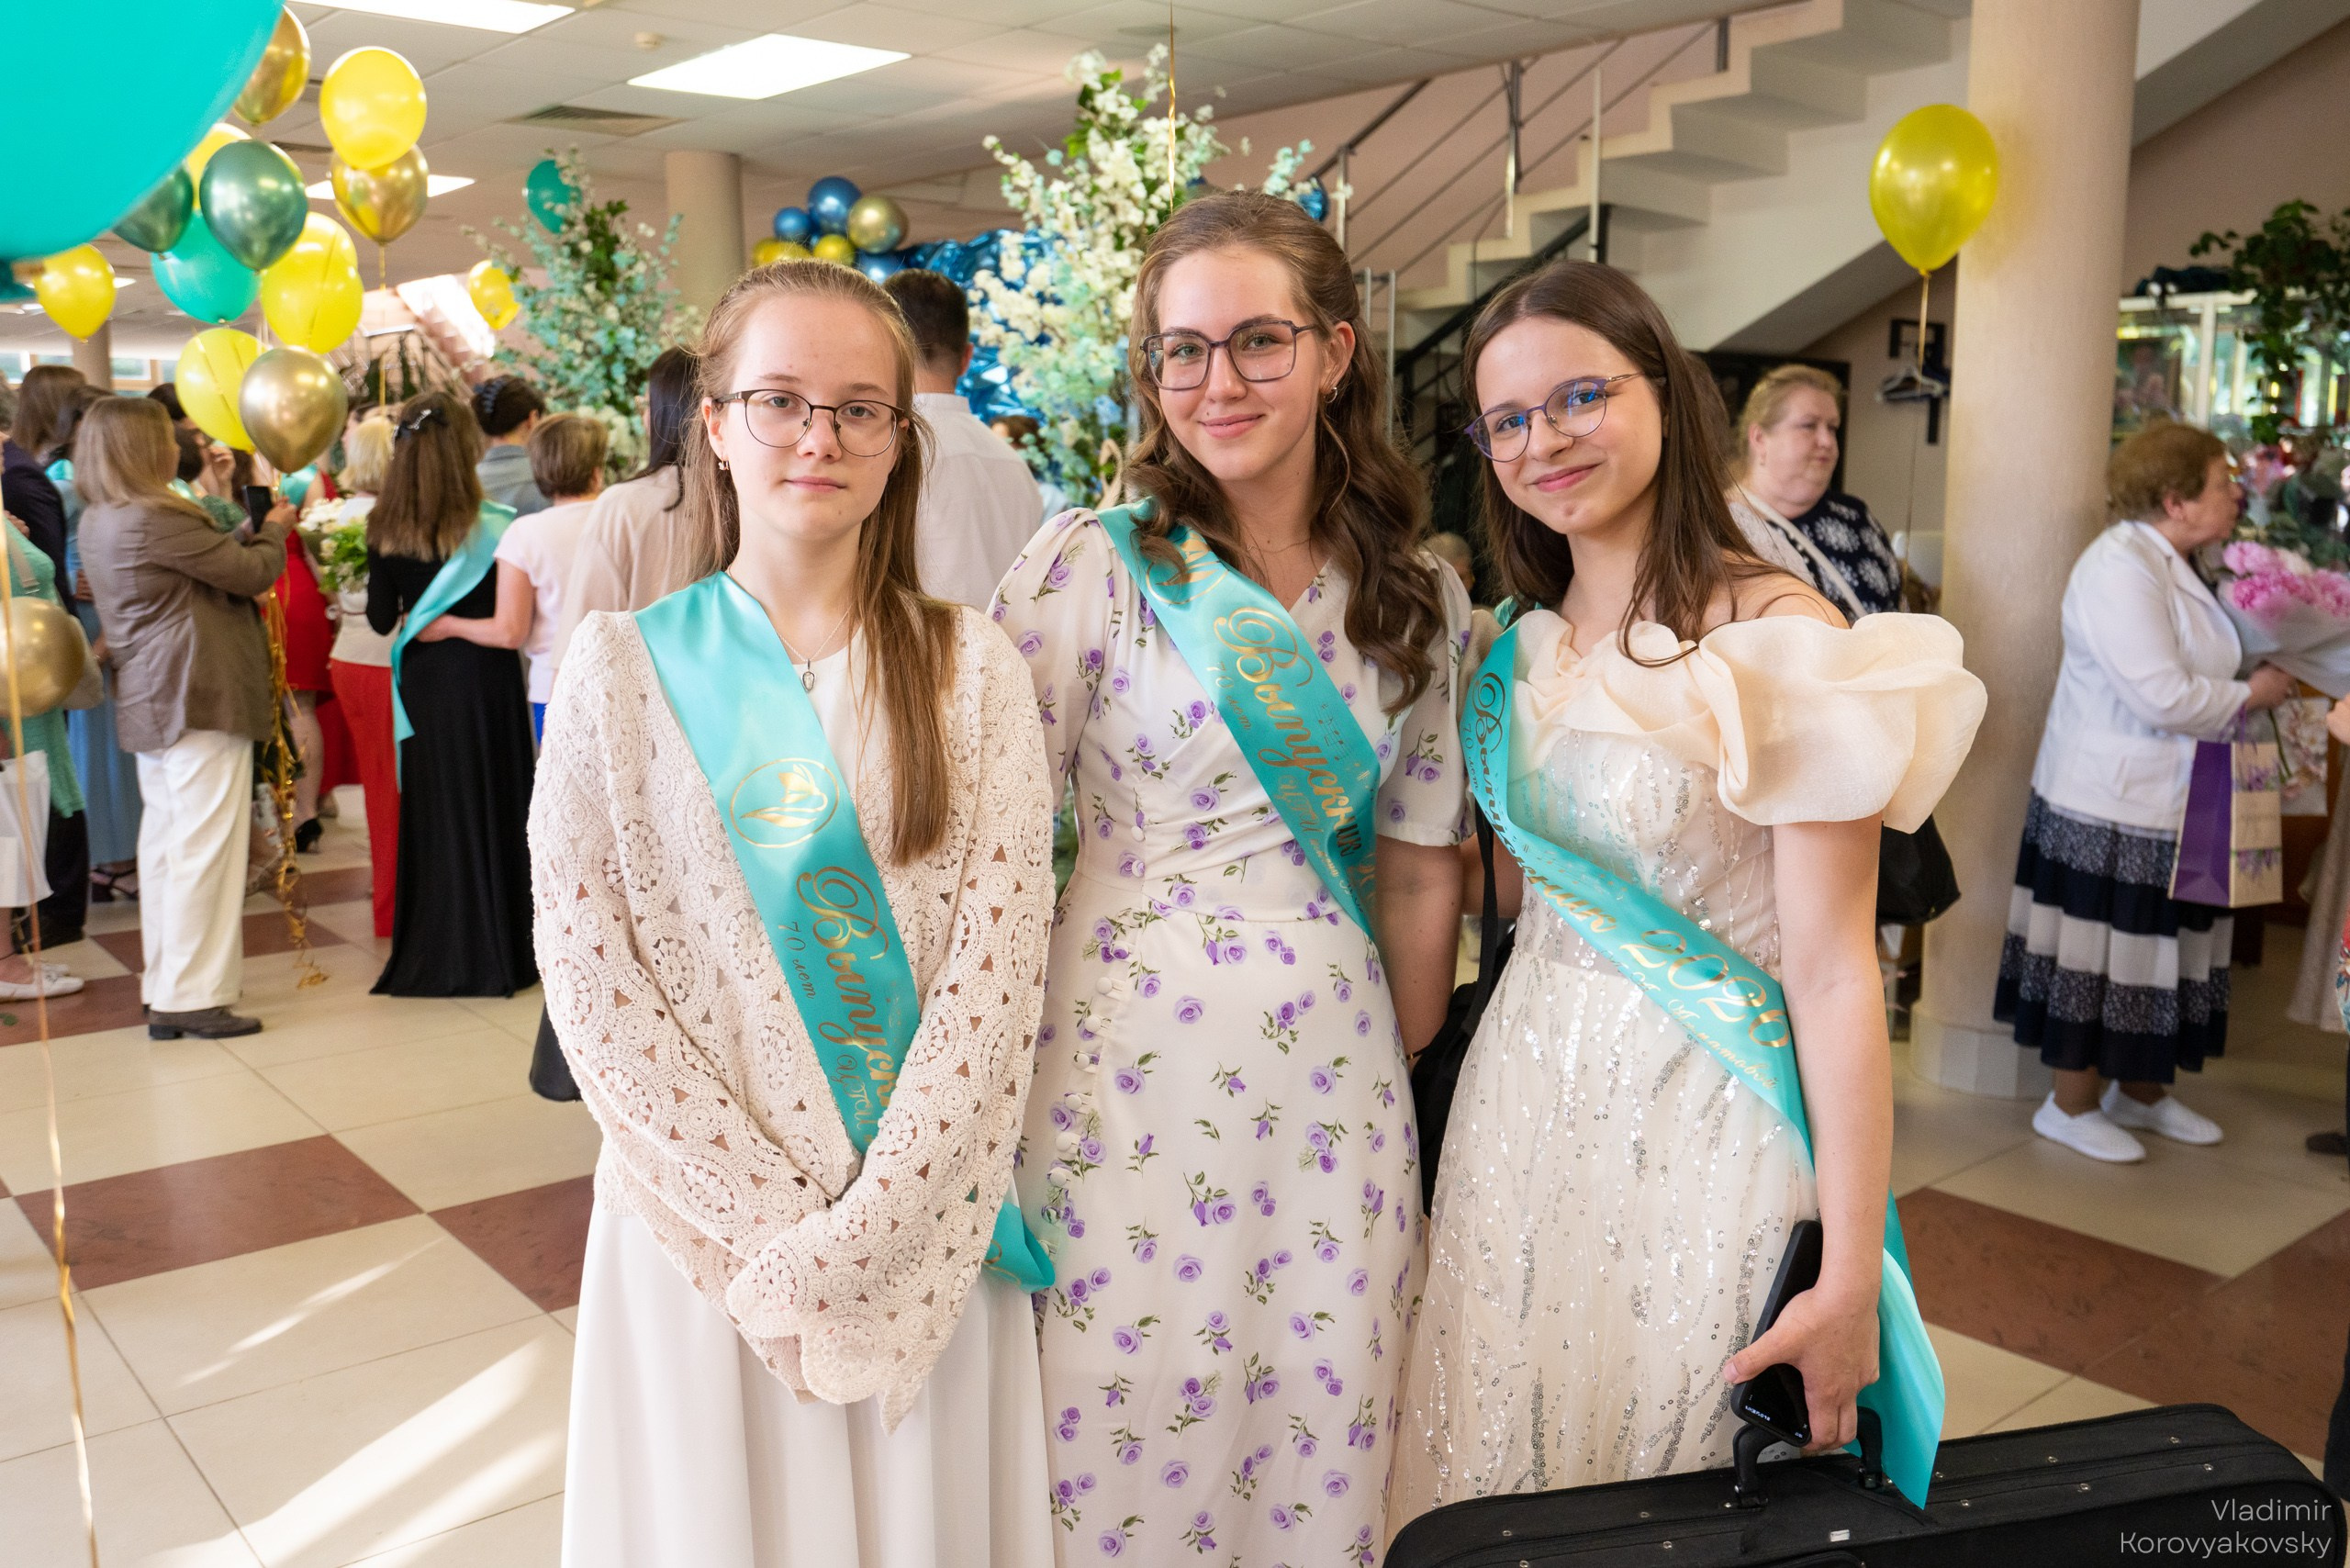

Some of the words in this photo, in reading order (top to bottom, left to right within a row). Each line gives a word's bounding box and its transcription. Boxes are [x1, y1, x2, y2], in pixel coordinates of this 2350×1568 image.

[1206, 661, 1235, 689] 70
[1226, 695, 1252, 731] лет
[1214, 606, 1361, 857] Выпускник
[1463, 723, 1474, 749] 70
[778, 921, 806, 951] 70
[792, 958, 814, 999] лет
[797, 866, 899, 1107] Выпуск
[1619, 930, 1789, 1048] 2026
